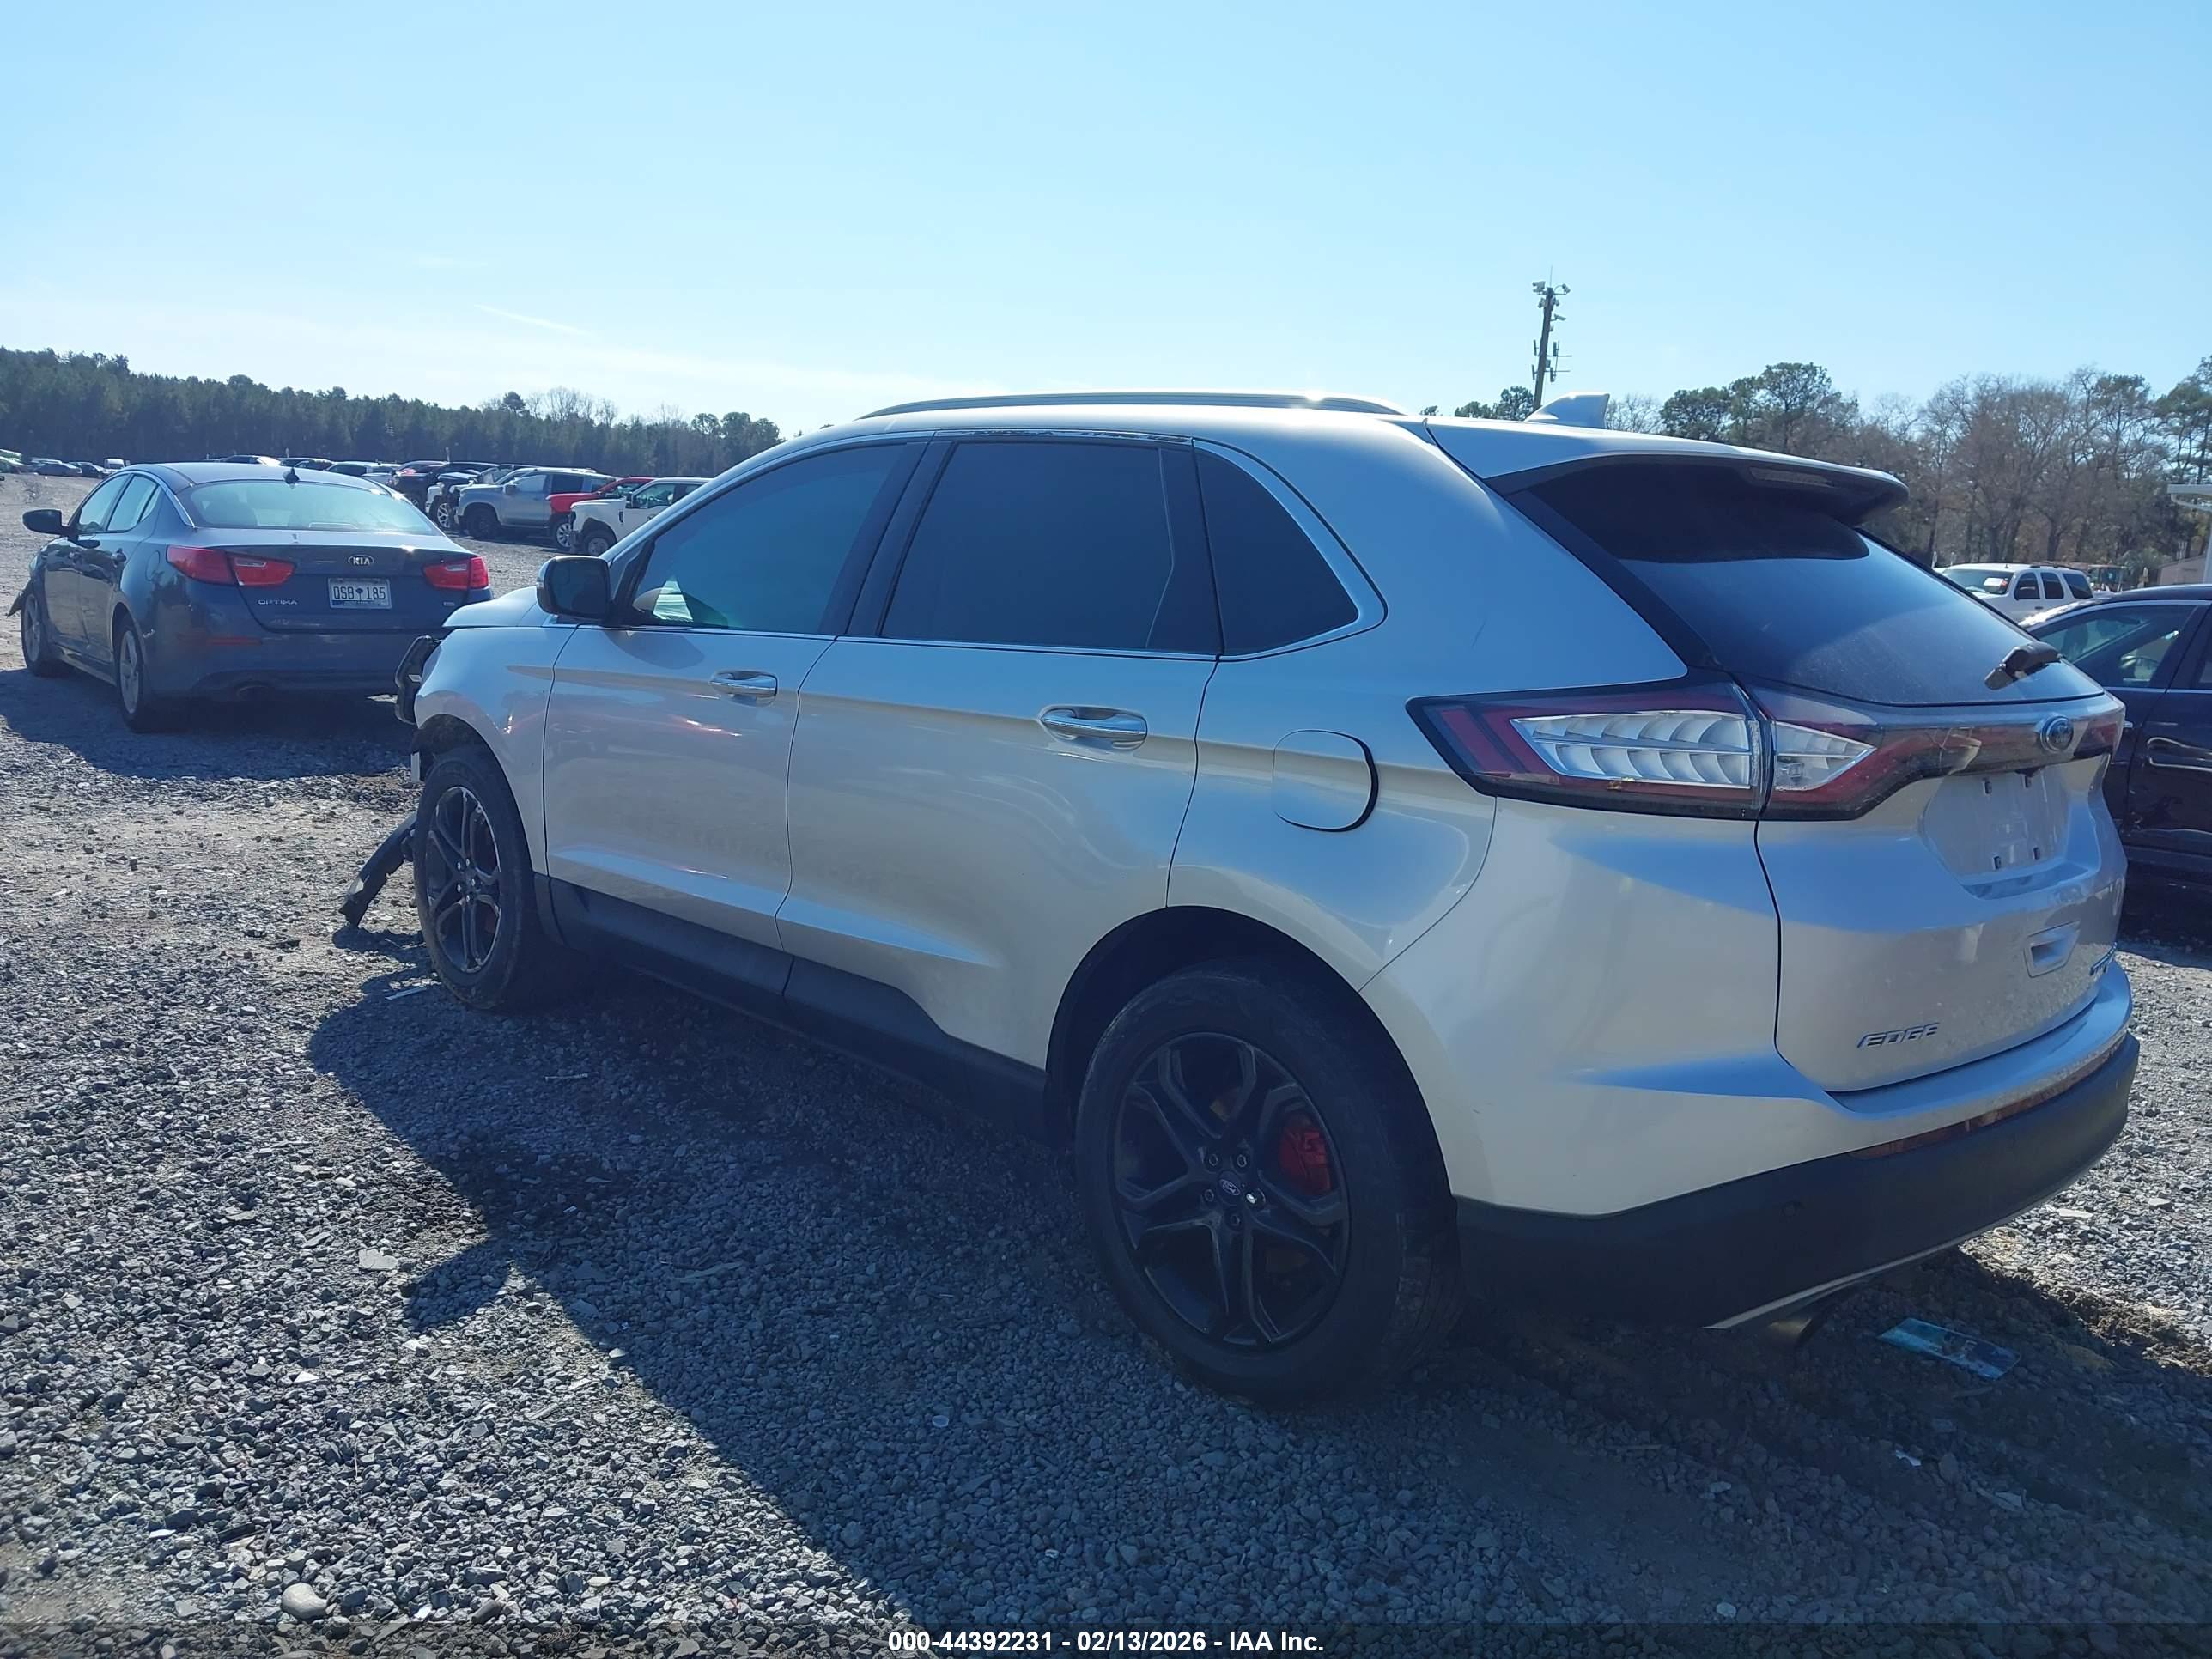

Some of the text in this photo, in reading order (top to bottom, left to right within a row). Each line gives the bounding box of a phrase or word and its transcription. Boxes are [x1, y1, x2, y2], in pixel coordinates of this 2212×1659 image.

[353, 557, 371, 566] KIA
[366, 586, 386, 600] 185
[1856, 1022, 1941, 1048] EDGE
